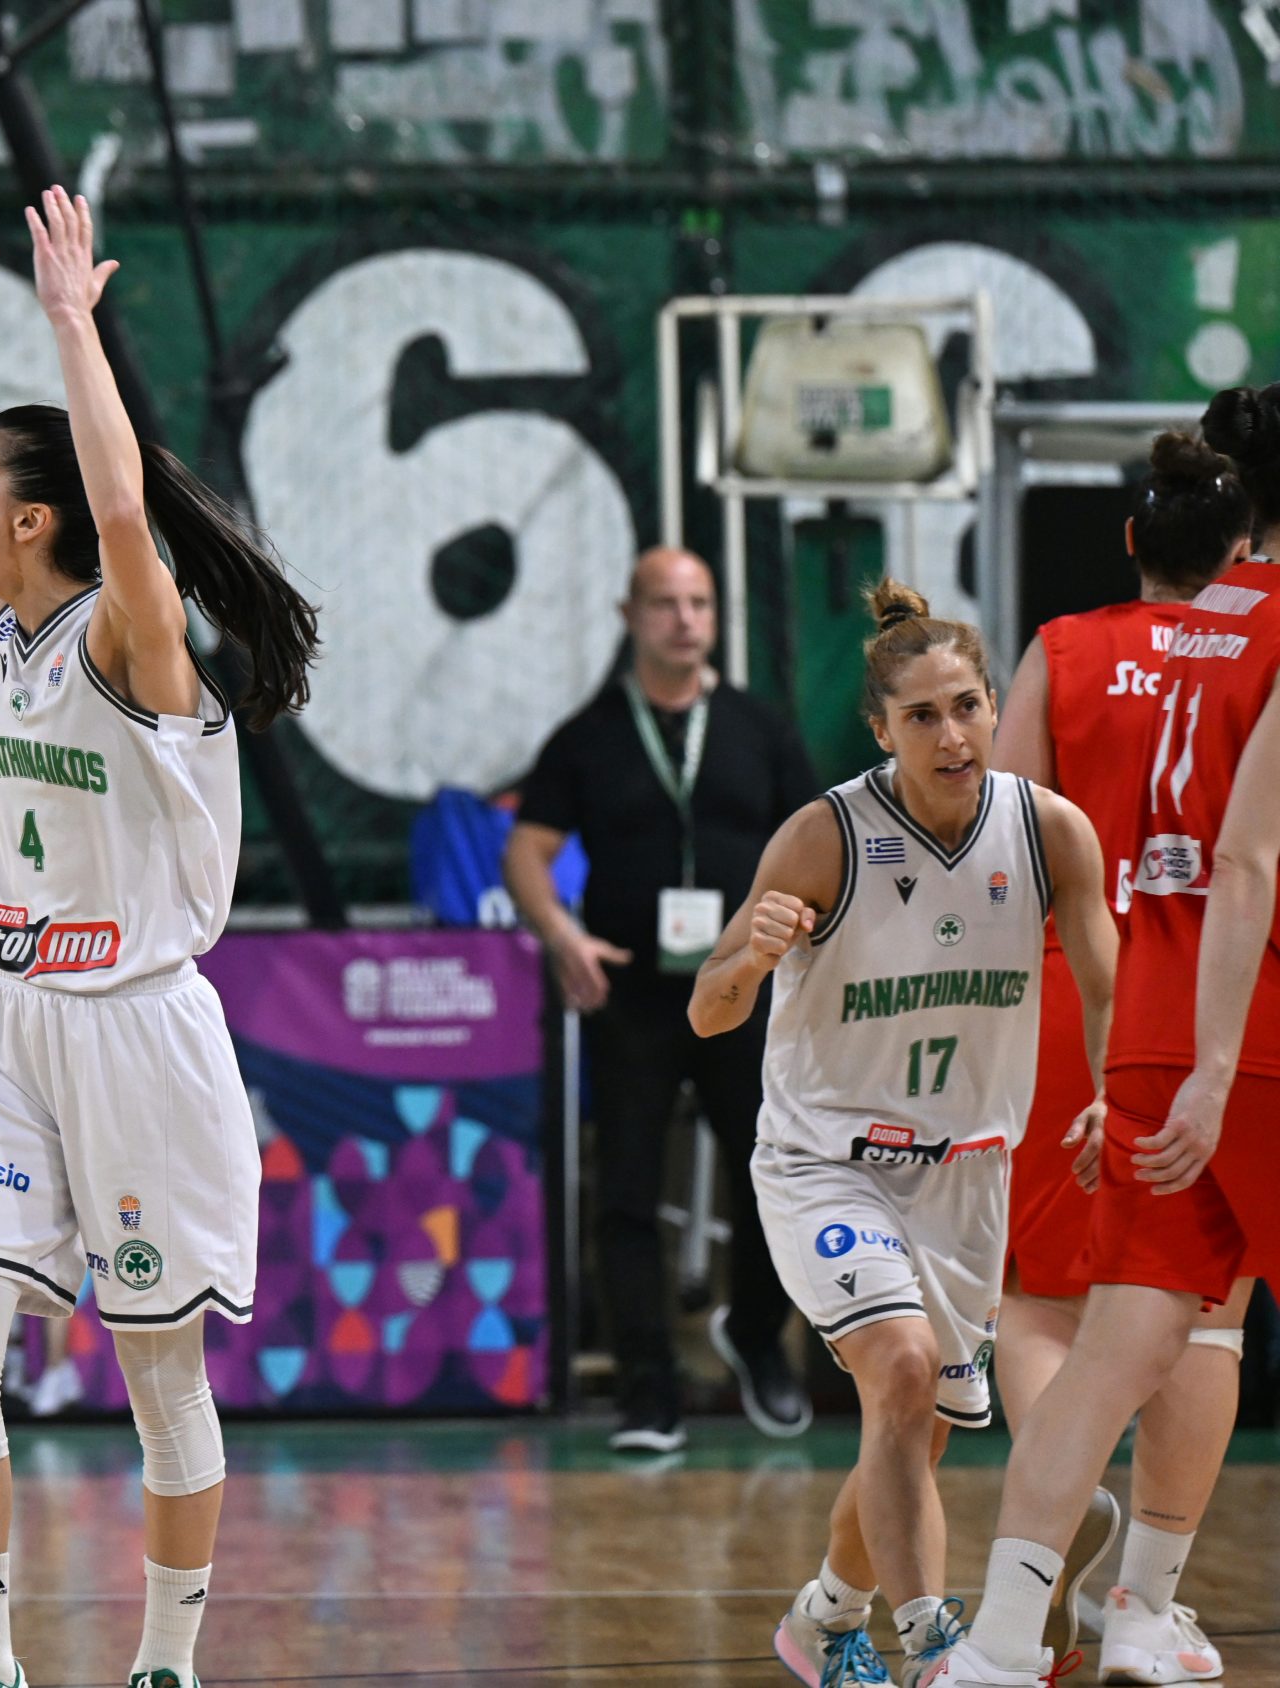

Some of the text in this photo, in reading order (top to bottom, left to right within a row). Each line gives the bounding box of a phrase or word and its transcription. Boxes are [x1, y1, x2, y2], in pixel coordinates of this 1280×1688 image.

[1150, 679, 1203, 816] 11
[19, 808, 45, 873] 4
[841, 970, 1029, 1023] PANATHINAIKOS
[906, 1034, 959, 1098] 17
[871, 1126, 910, 1144] pame
[86, 1251, 109, 1275] ance
